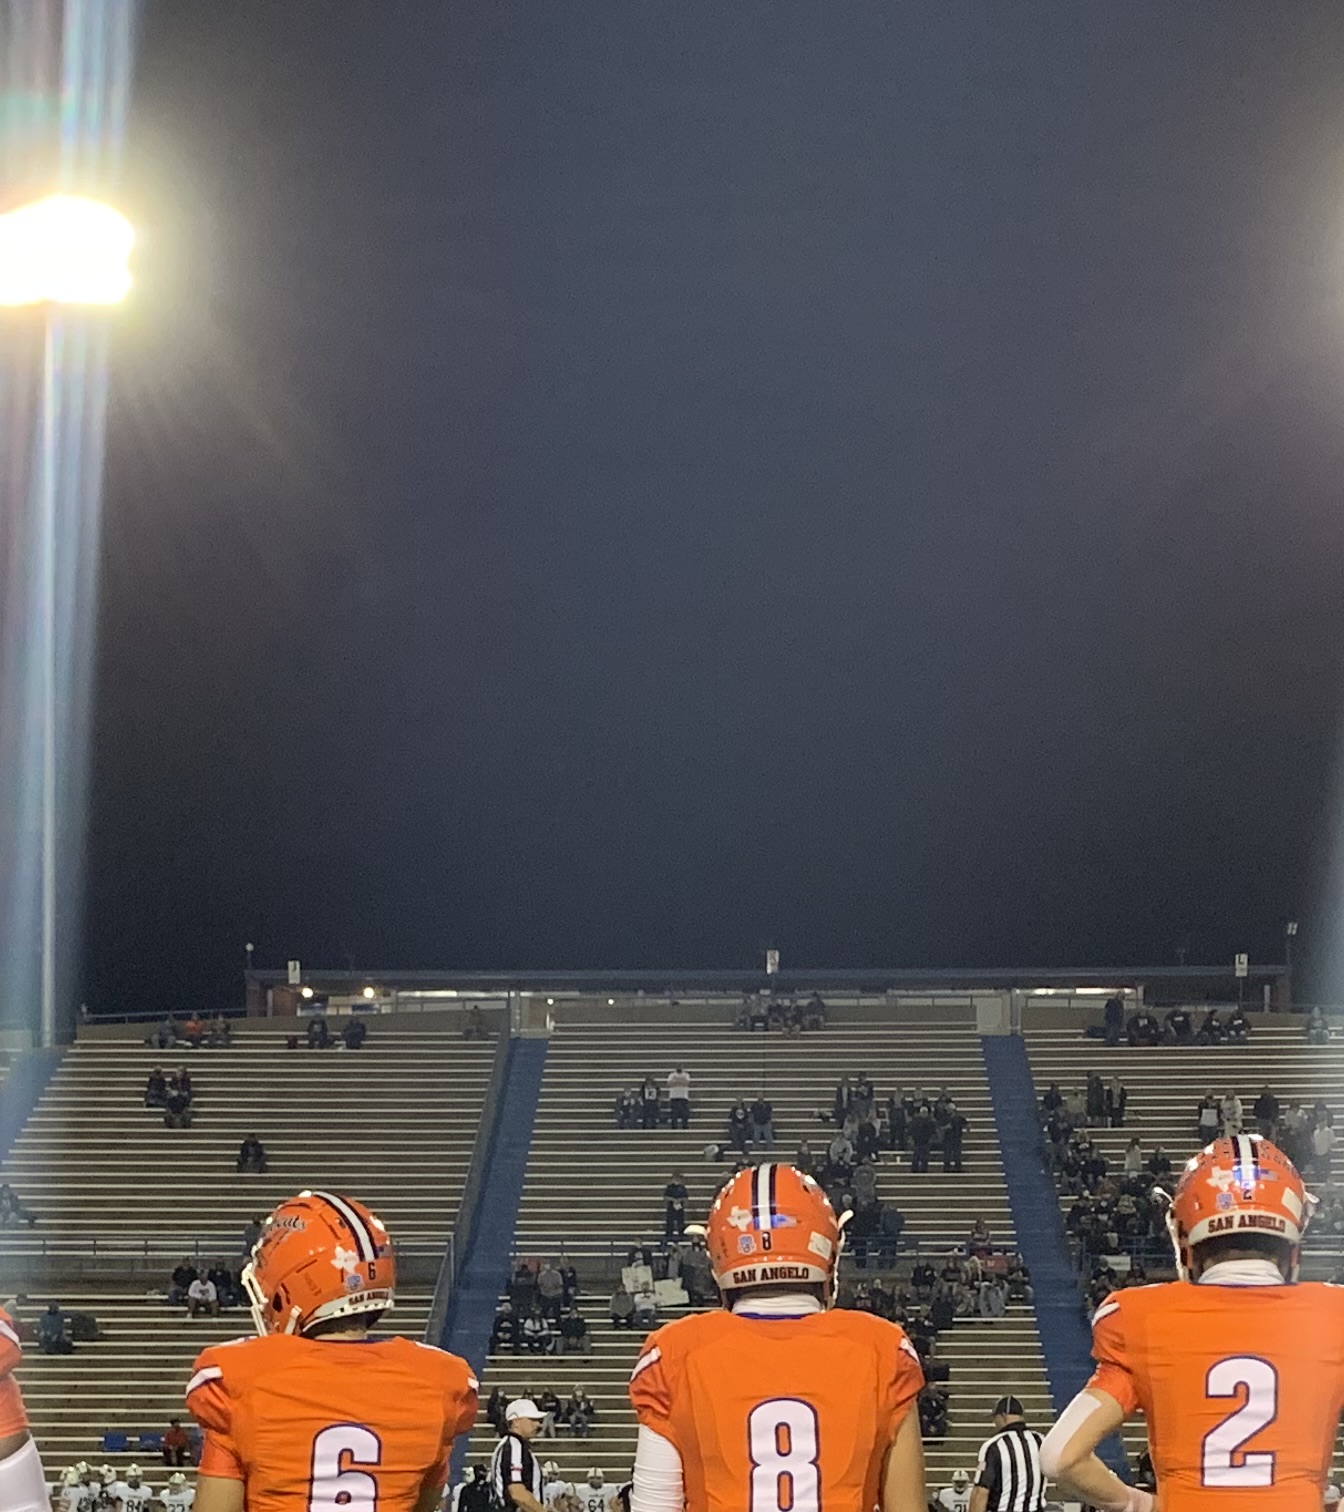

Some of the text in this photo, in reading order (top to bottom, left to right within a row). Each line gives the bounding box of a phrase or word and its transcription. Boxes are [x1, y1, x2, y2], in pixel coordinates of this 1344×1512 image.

[1208, 1215, 1285, 1233] SAN ANGELO
[762, 1231, 771, 1251] 8
[368, 1262, 376, 1280] 6
[733, 1267, 809, 1284] SAN ANGELO
[1201, 1355, 1278, 1487] 2
[588, 1499, 605, 1512] 64
